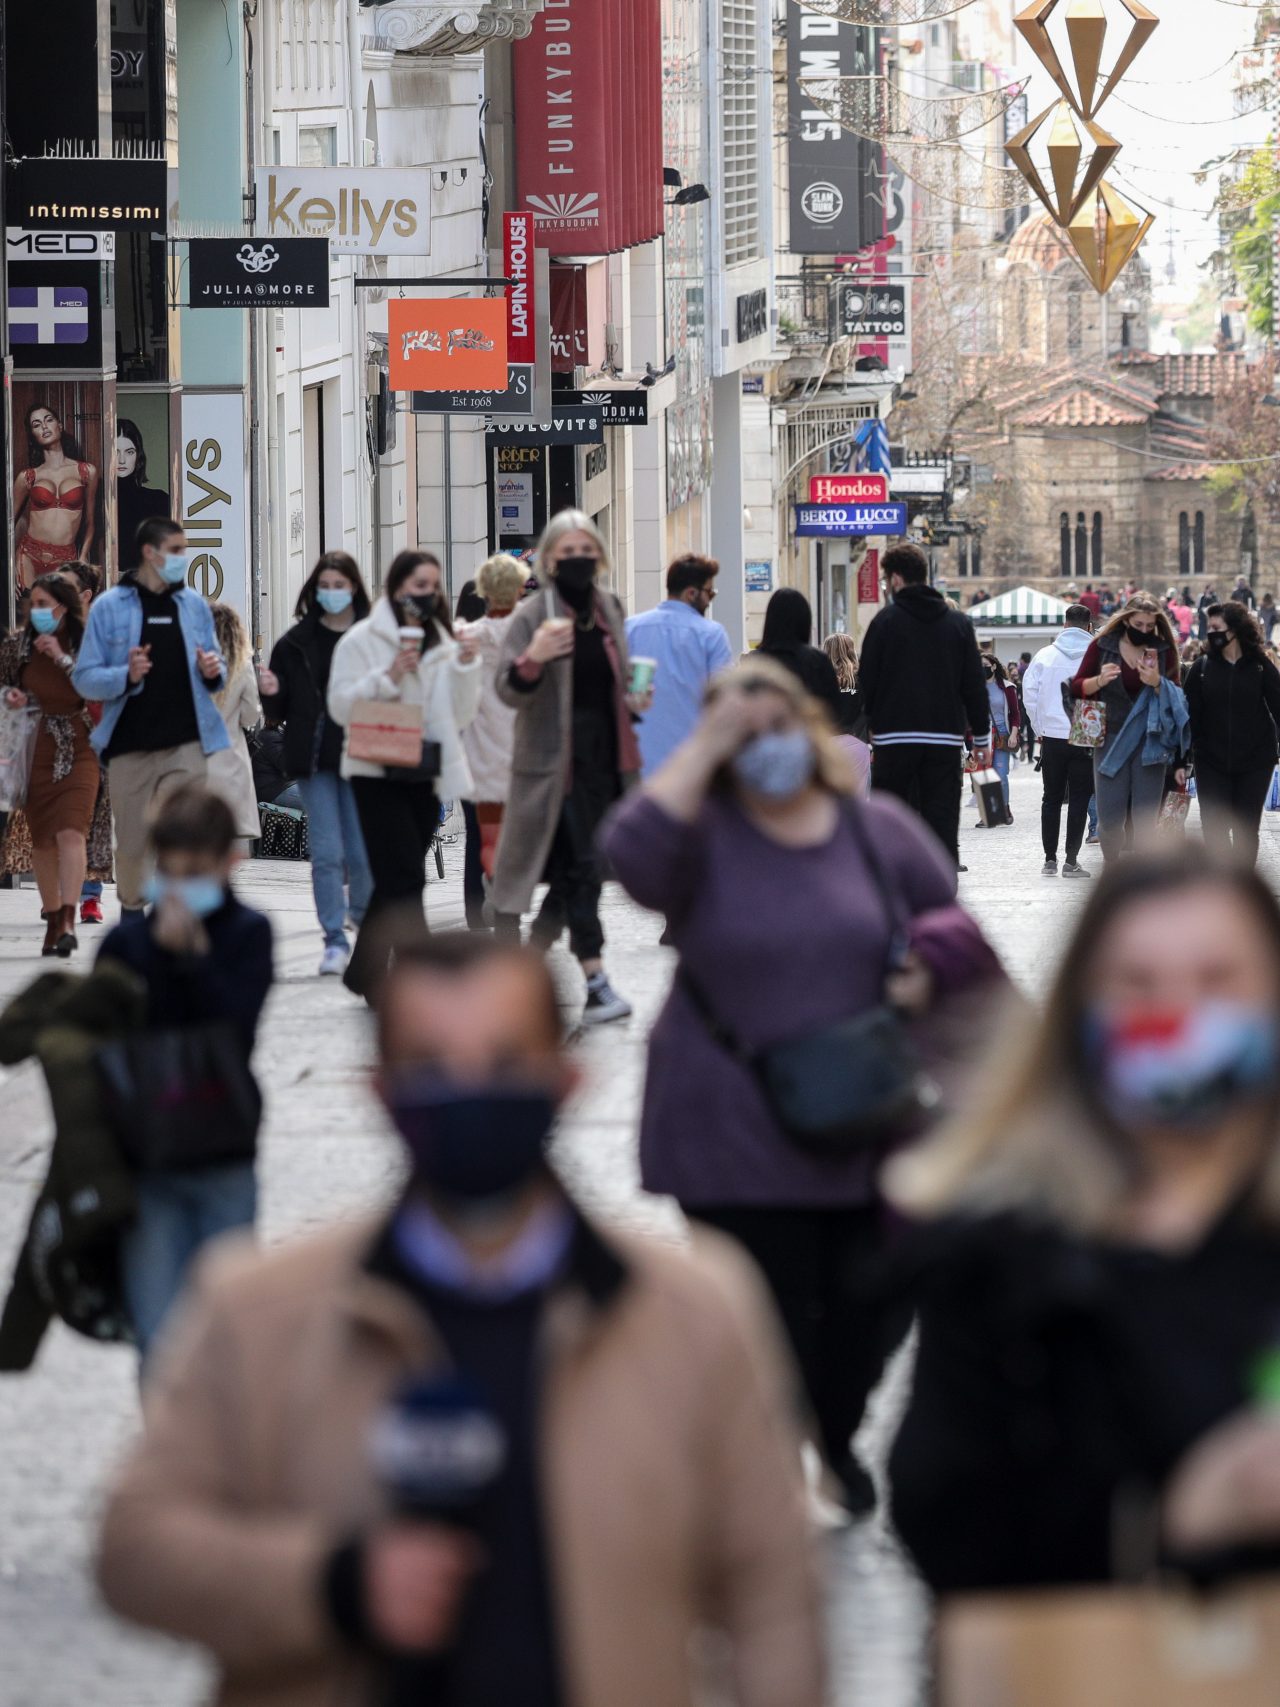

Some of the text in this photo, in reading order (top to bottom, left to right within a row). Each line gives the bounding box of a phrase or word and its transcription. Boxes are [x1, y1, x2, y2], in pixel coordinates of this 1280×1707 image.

[29, 203, 160, 219] intimissimi
[511, 216, 528, 337] LAPIN HOUSE
[202, 285, 315, 295] JULIA MORE
[844, 322, 904, 333] TATTOO
[452, 396, 492, 410] Est 1968
[815, 480, 882, 497] Hondos
[800, 508, 898, 522] BERTO LUCCI
